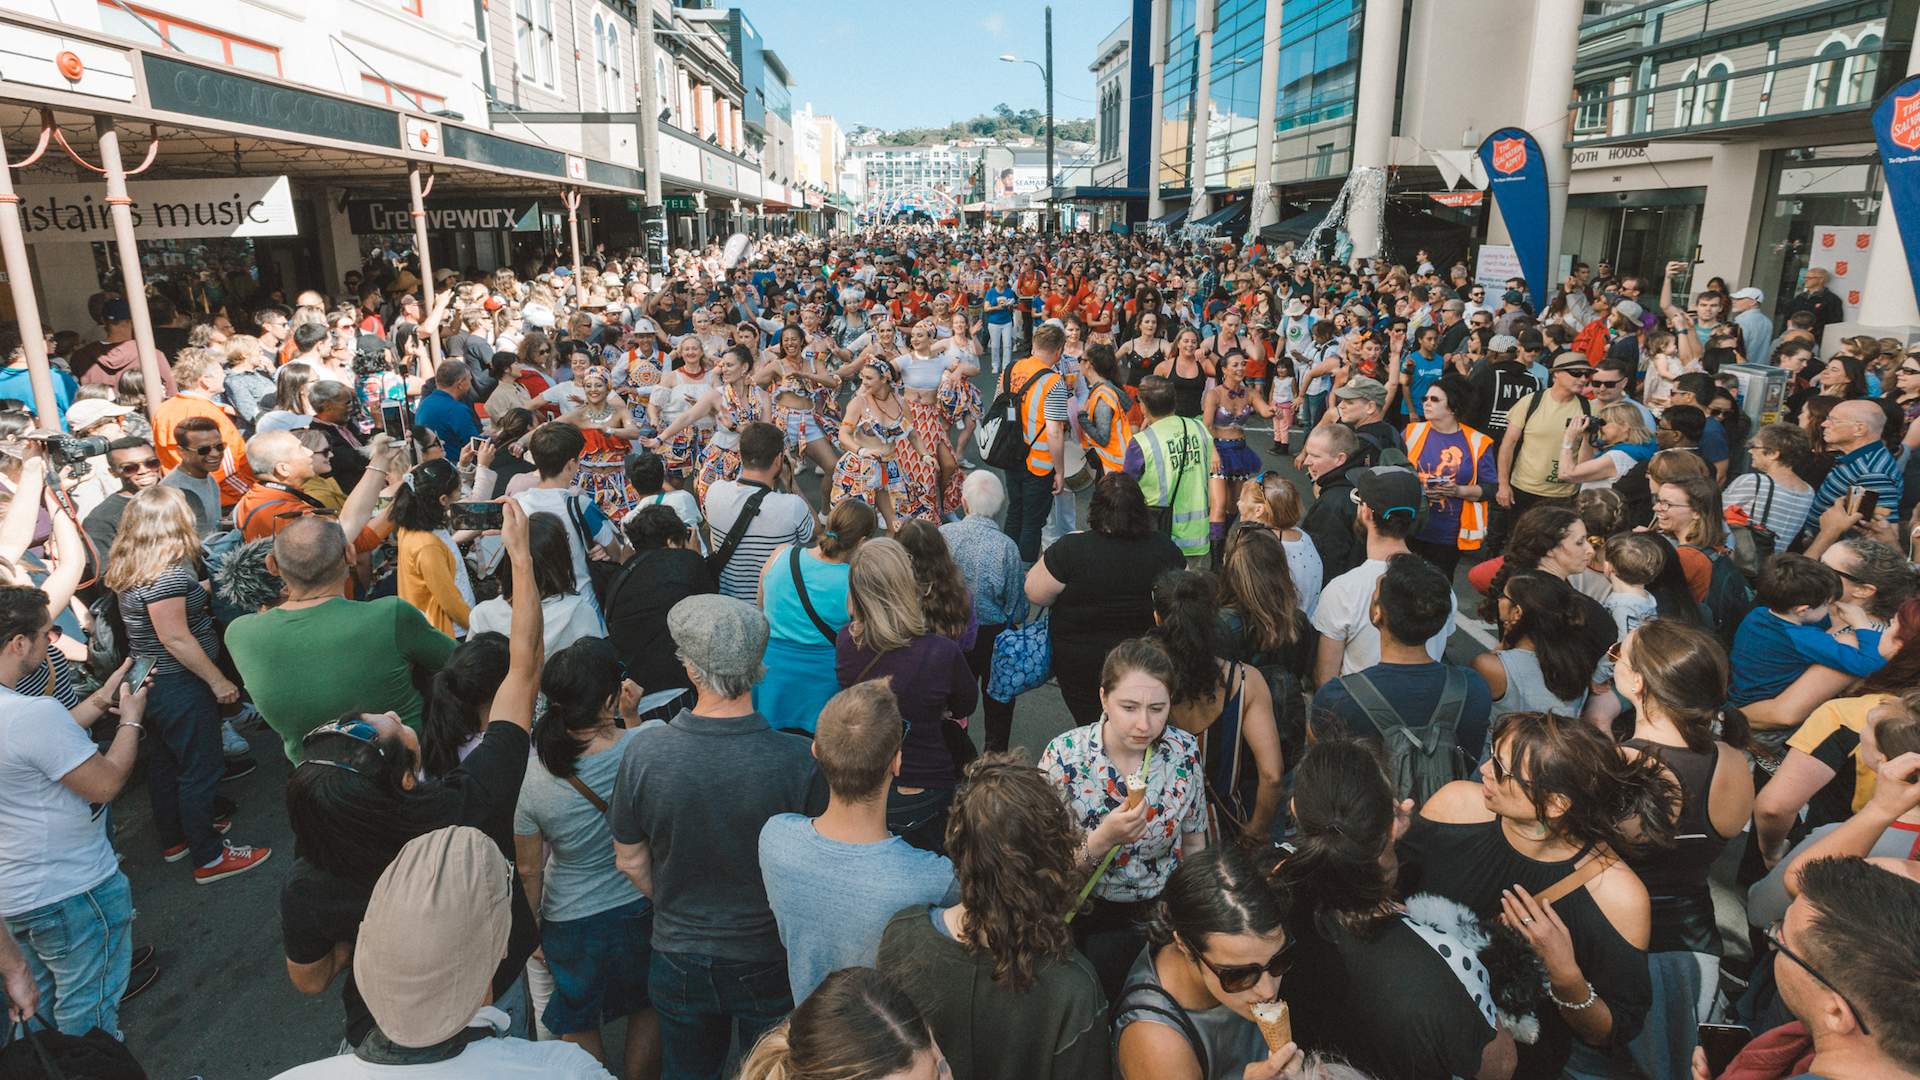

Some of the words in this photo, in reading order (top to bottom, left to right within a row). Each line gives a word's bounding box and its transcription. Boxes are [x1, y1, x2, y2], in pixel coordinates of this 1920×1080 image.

[174, 70, 290, 121] COSMIC
[1608, 146, 1646, 160] HOUSE
[152, 192, 270, 229] music
